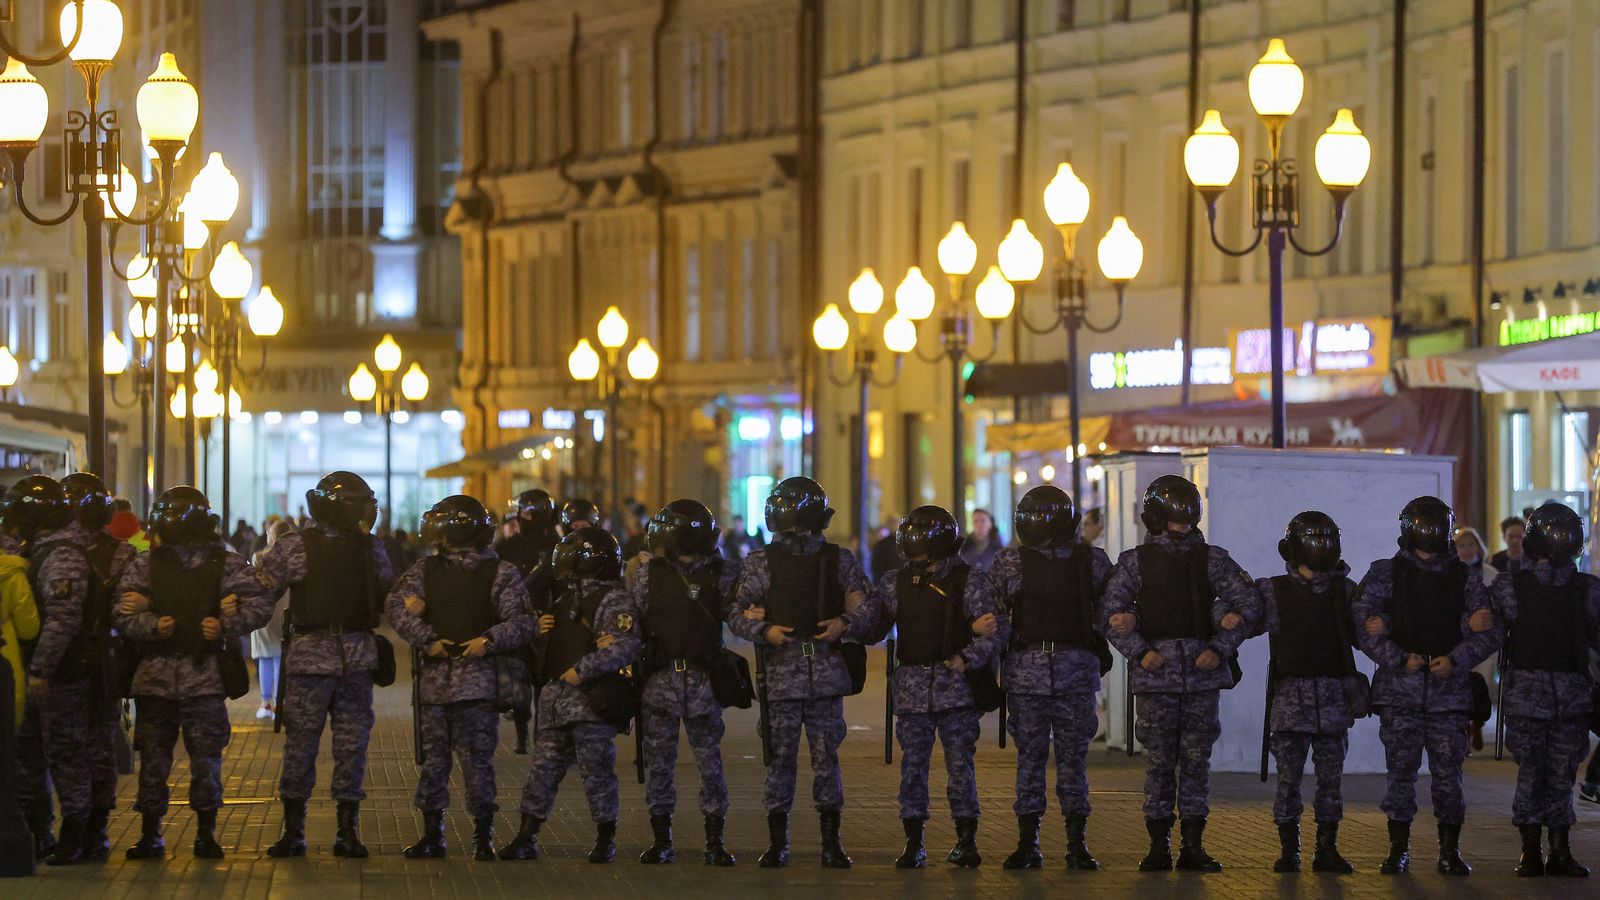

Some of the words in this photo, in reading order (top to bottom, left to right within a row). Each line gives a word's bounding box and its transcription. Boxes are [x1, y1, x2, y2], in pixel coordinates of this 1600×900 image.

[1540, 367, 1580, 381] КАФЕ
[1134, 425, 1237, 446] ТУРЕЦКАЯ
[1243, 426, 1310, 444] КУНЯ
